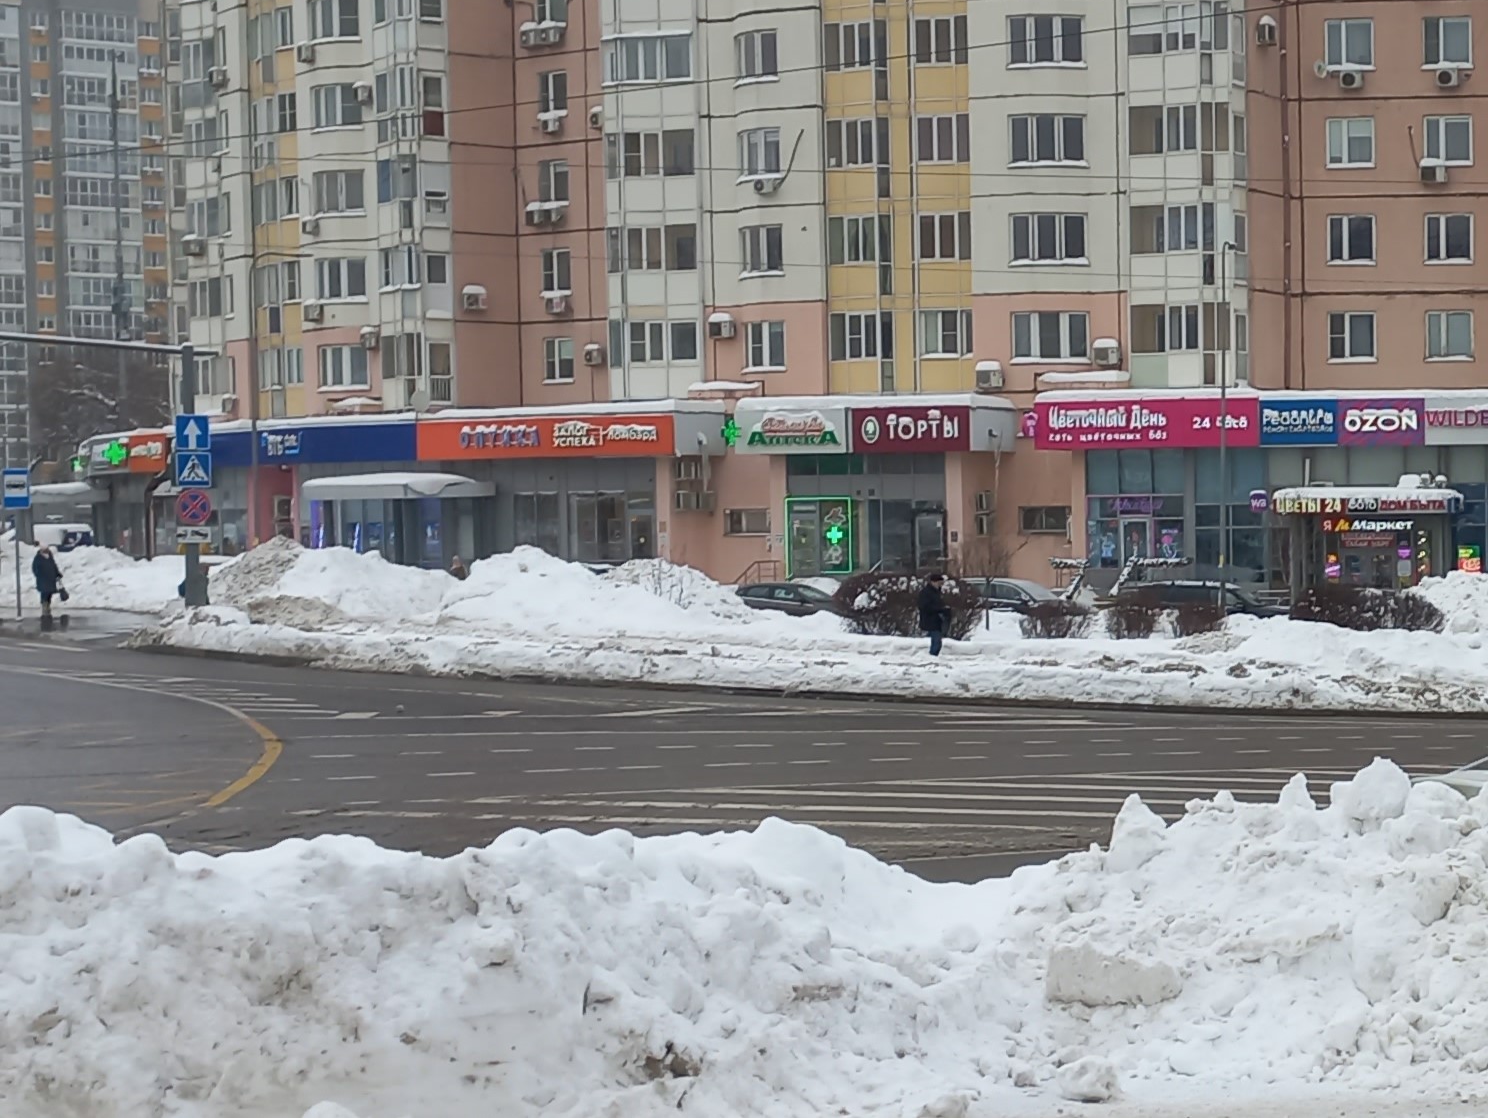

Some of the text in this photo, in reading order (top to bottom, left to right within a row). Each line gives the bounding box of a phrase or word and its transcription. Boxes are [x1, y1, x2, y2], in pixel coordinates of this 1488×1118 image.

[1048, 405, 1167, 430] Цветочный День
[1192, 416, 1211, 429] 24
[1344, 410, 1418, 432] OZON
[886, 415, 959, 440] ТОРТЫ
[1325, 498, 1342, 512] 24
[1351, 520, 1414, 532] Маркет
